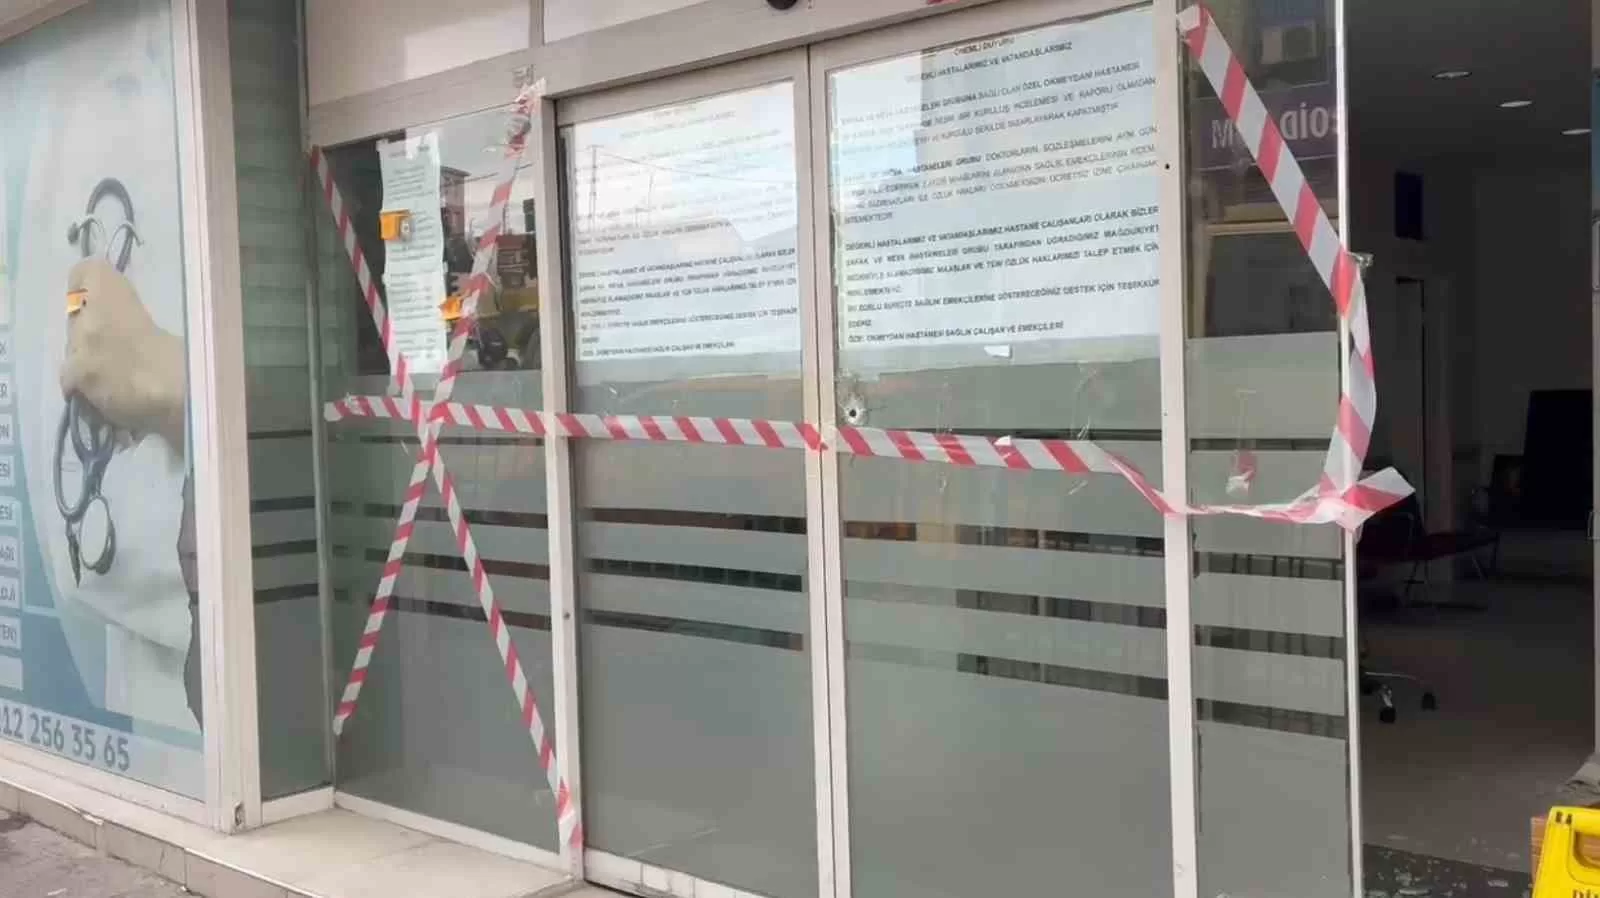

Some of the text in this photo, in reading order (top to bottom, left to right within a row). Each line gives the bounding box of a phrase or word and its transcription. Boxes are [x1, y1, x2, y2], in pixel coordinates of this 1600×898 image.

[927, 233, 936, 242] VE
[1004, 220, 1040, 233] HASTANE
[1093, 209, 1128, 222] OLARAK
[973, 261, 983, 269] VE
[1112, 244, 1140, 255] ETMEK
[1062, 283, 1096, 294] DESTEK
[1006, 324, 1016, 333] VE
[29, 712, 65, 752] 256
[71, 723, 97, 761] 35
[103, 734, 131, 772] 65
